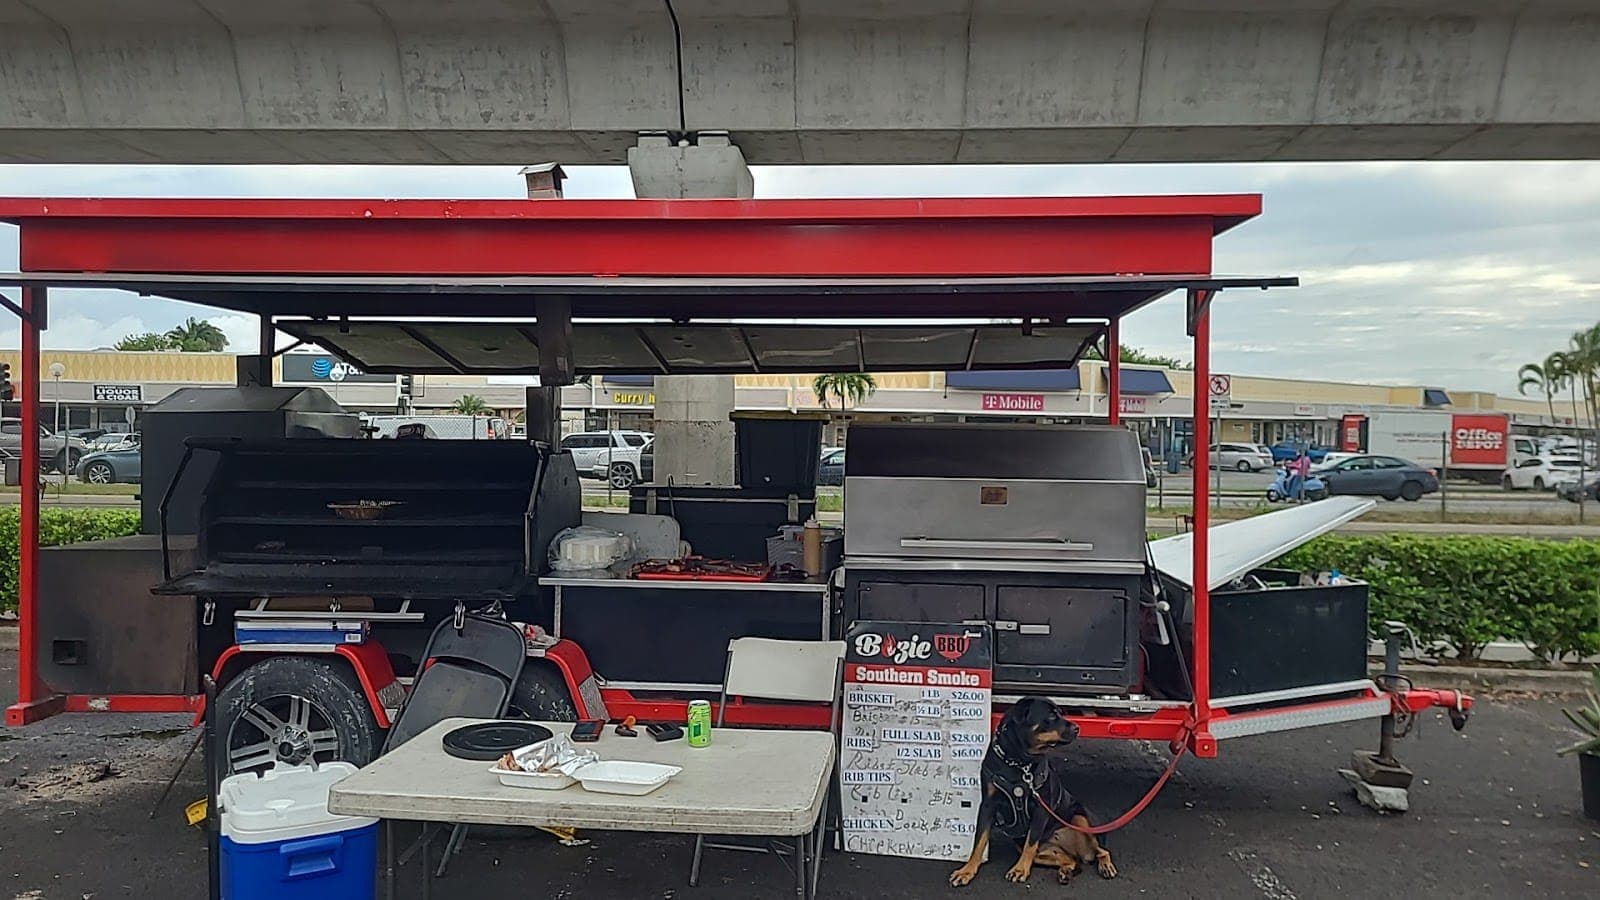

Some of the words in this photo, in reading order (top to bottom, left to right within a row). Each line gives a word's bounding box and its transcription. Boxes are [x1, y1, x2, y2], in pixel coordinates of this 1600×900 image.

[333, 362, 364, 375] AT&
[614, 392, 644, 405] Curry
[1455, 428, 1503, 440] Office
[1455, 440, 1503, 449] DEPOT
[939, 637, 966, 652] BBQ
[856, 666, 923, 684] Southern
[927, 669, 980, 686] Smoke
[849, 693, 893, 704] BRISKET
[928, 690, 940, 698] LB
[951, 691, 985, 701] $26.00
[928, 706, 940, 715] LB
[951, 707, 983, 717] $16.00
[883, 729, 910, 740] FULL
[913, 730, 941, 741] SLAB
[951, 732, 985, 743] $28.00
[847, 737, 872, 748] RIBS
[897, 748, 910, 757] 1/2
[913, 748, 941, 758] SLAB
[951, 748, 983, 758] $16.00
[844, 772, 864, 782] RIB
[869, 772, 891, 782] TIPS
[842, 819, 894, 829] CHICKEN
